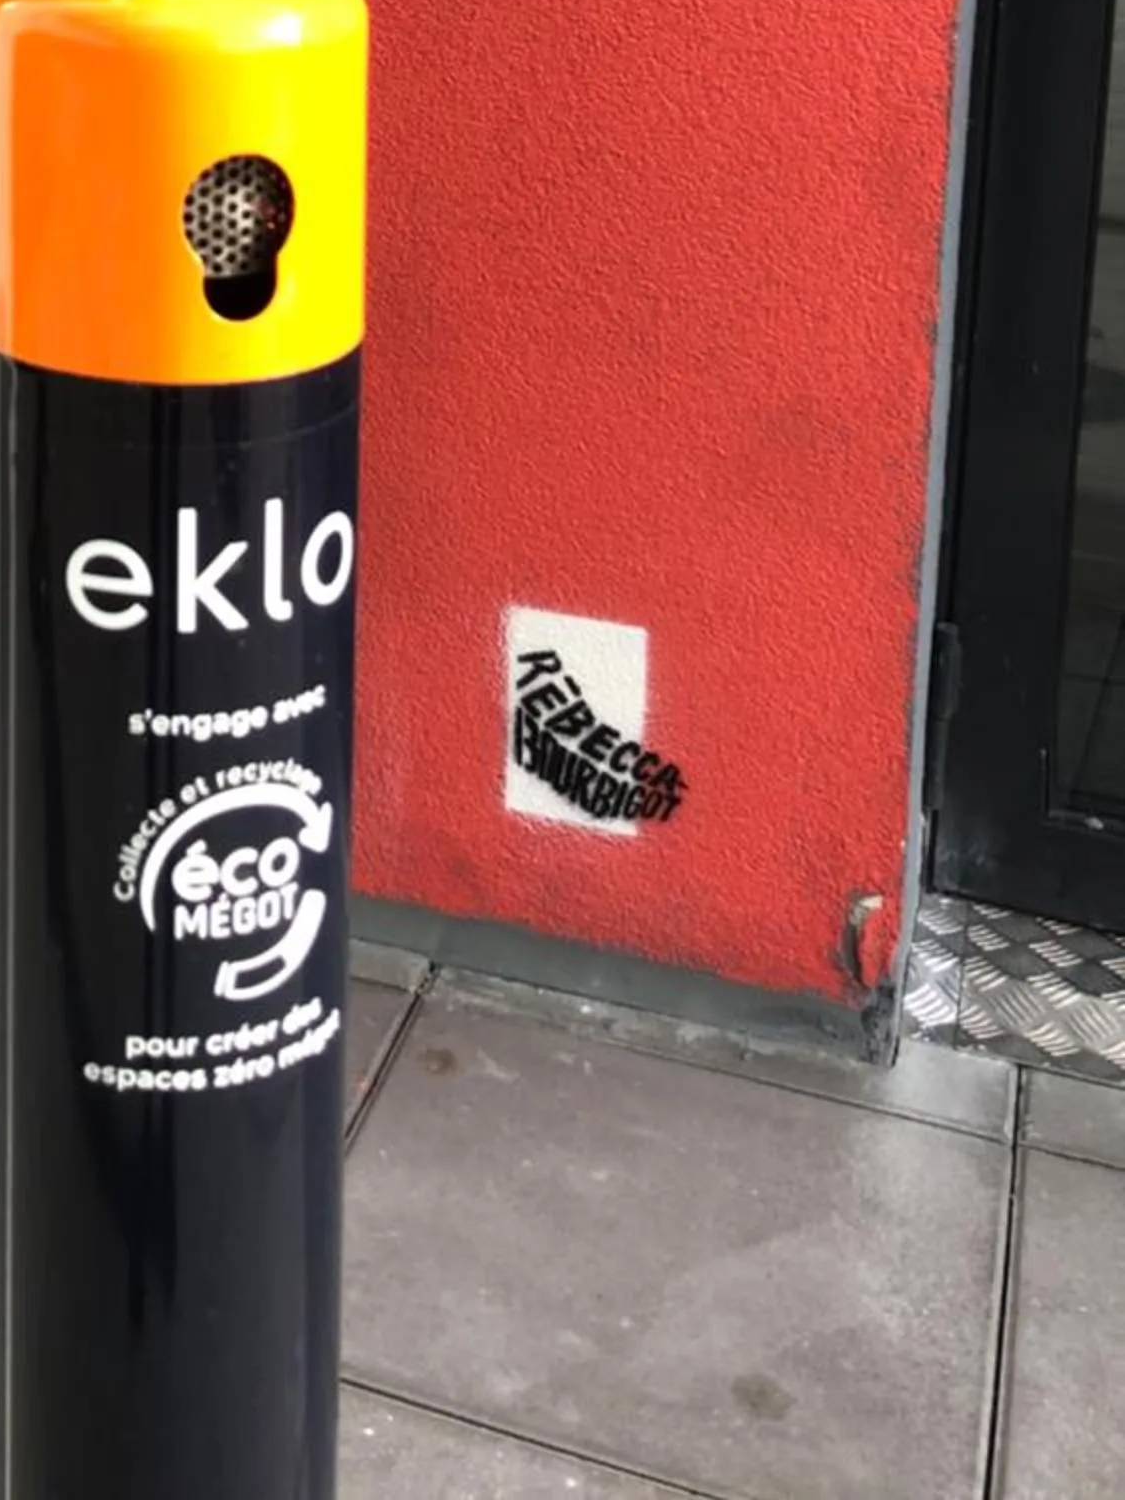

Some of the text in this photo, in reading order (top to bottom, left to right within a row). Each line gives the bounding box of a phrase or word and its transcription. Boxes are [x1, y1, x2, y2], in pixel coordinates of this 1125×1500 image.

[65, 497, 355, 634] eklo
[129, 708, 268, 742] s'engage
[113, 798, 176, 901] Collecte
[180, 777, 210, 804] et
[171, 836, 300, 902] éco
[174, 882, 299, 941] MÉGOT
[83, 1062, 207, 1092] espaces
[125, 1035, 199, 1060] pour
